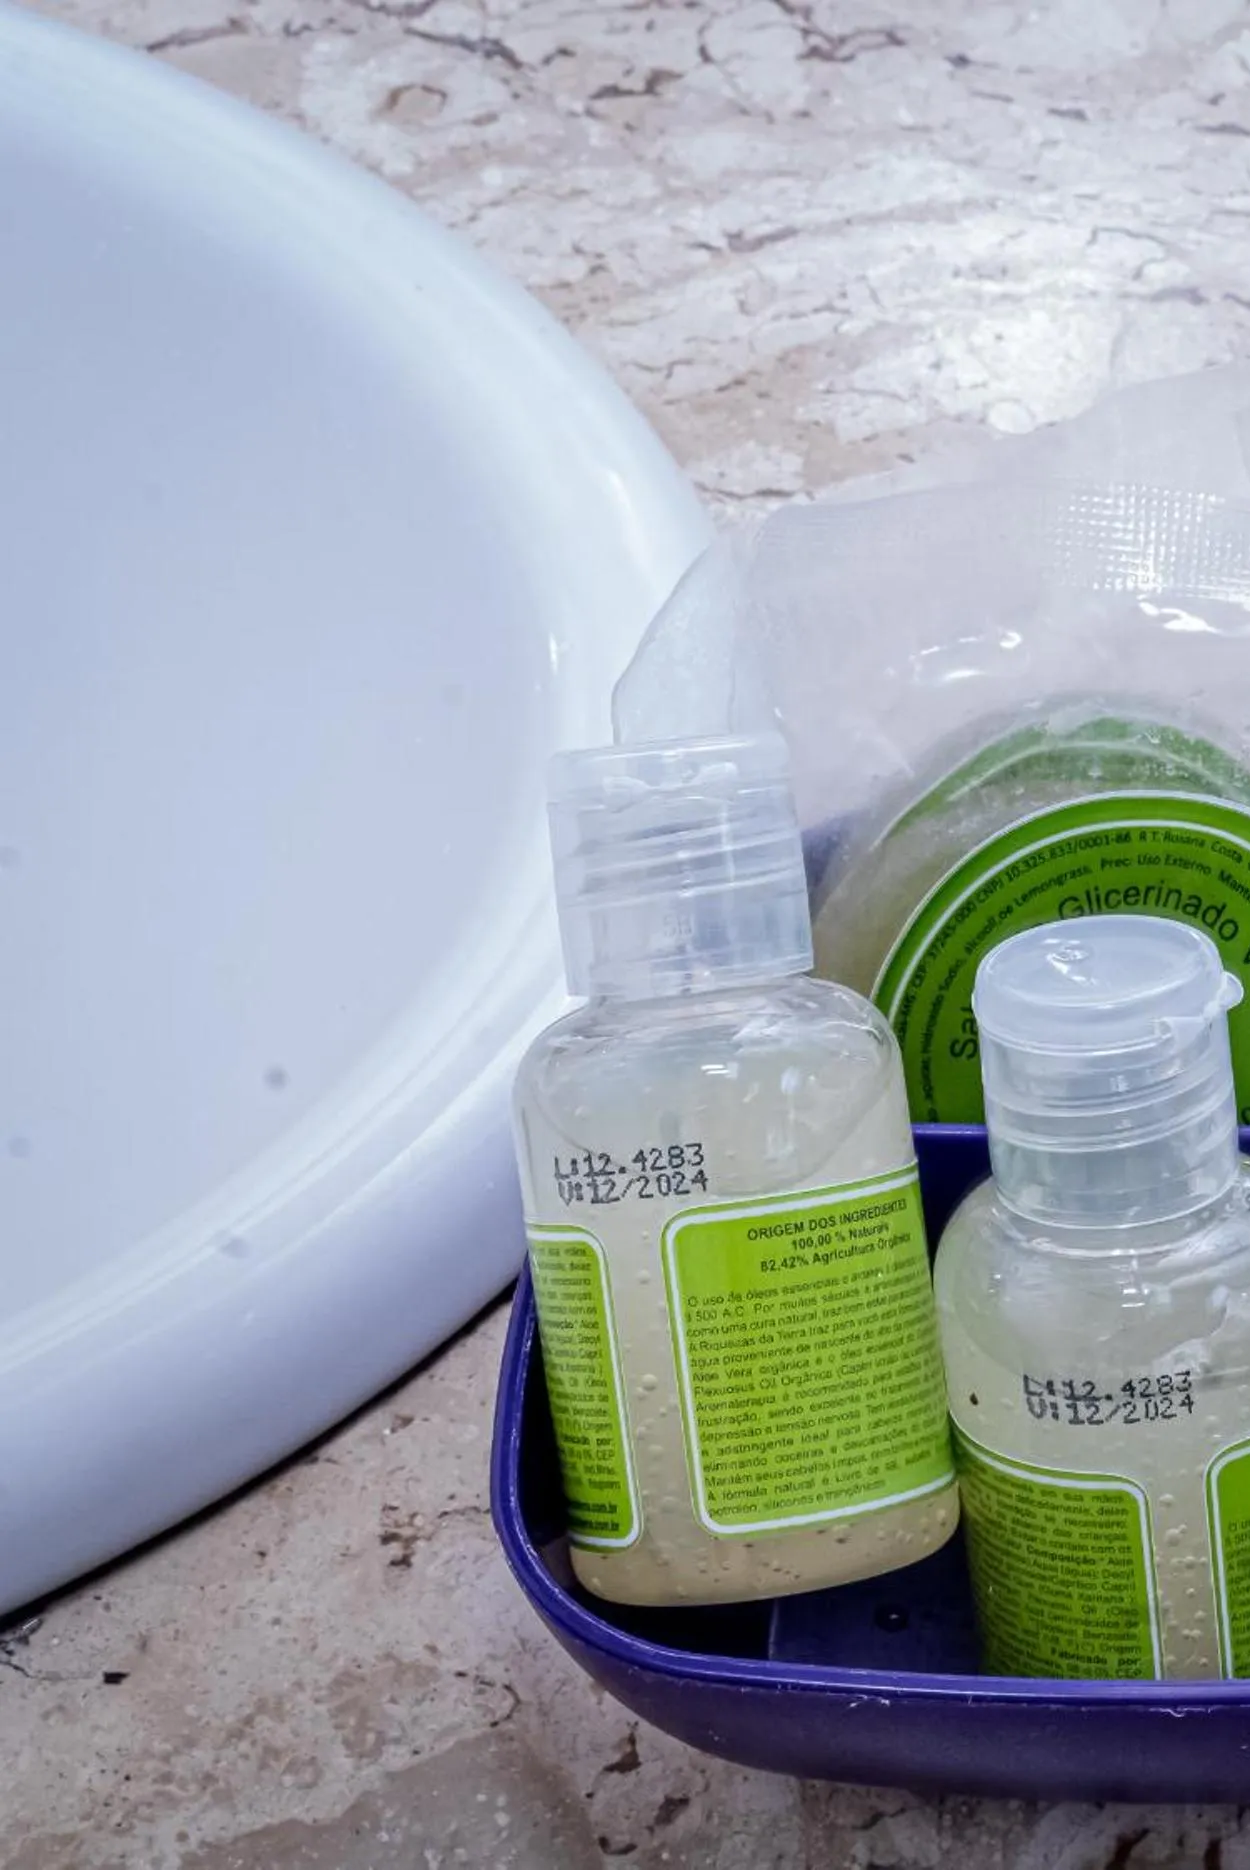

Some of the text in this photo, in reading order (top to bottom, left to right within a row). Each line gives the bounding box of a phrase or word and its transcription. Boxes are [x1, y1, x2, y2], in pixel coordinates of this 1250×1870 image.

[1057, 879, 1239, 942] Glicerinado
[747, 1221, 804, 1241] ORIGEM
[809, 1214, 836, 1232] DOS
[812, 1243, 875, 1266] Agricultura
[703, 1296, 725, 1306] uso
[721, 1322, 748, 1335] uma
[749, 1317, 776, 1331] cura
[758, 1333, 775, 1345] da
[724, 1366, 753, 1379] Vera
